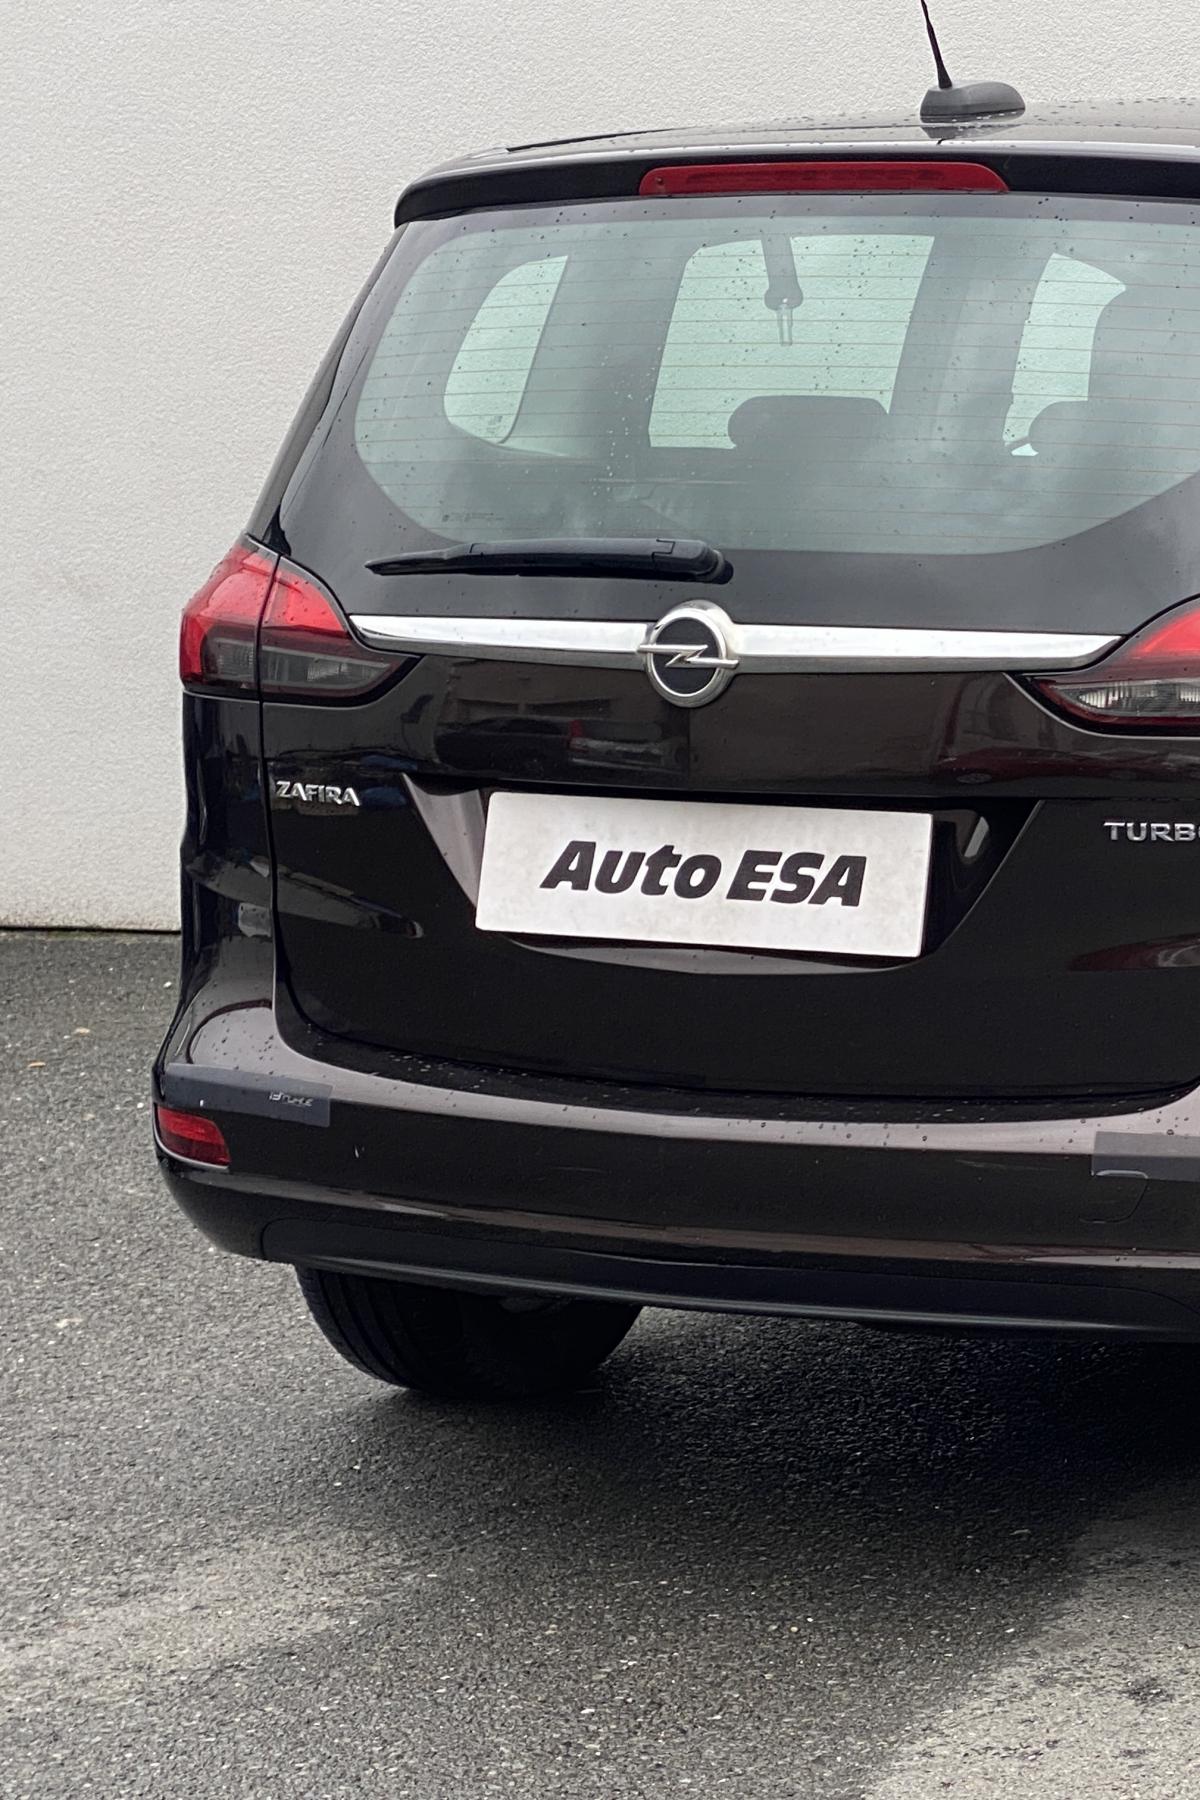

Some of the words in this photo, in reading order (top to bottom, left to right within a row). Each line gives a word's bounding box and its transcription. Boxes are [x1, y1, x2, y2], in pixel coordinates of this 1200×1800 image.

[276, 780, 360, 806] ZAFIRA
[539, 840, 722, 899] Auto
[726, 849, 867, 907] ESA
